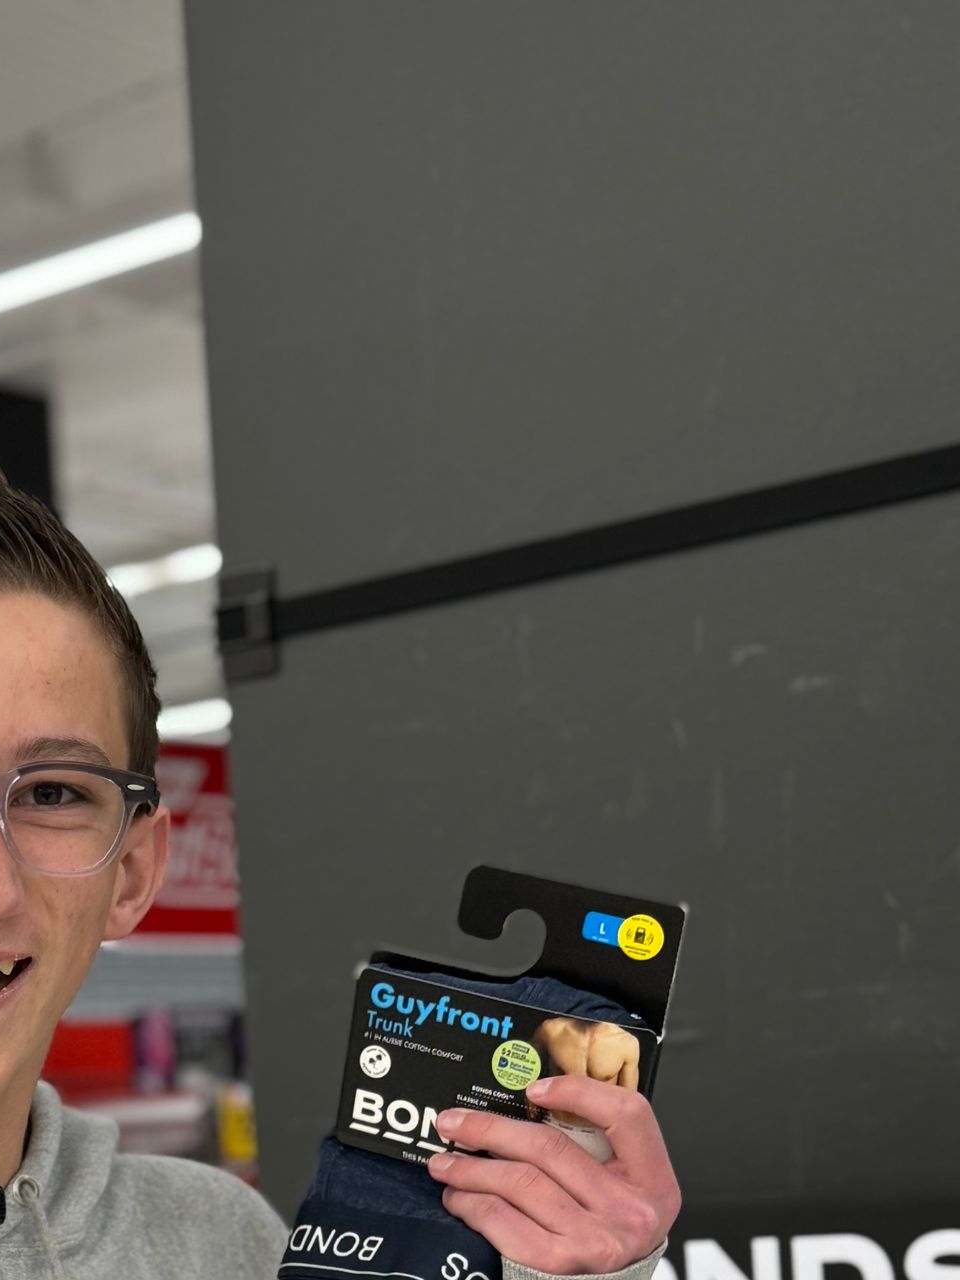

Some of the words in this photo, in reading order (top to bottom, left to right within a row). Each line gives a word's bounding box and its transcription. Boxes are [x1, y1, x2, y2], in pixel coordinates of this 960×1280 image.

[599, 922, 606, 935] L
[367, 1010, 414, 1038] Trunk
[371, 982, 513, 1040] Guyfront
[374, 1033, 382, 1042] IN
[382, 1036, 403, 1047] AUSSIE
[404, 1041, 431, 1053] COTTON
[432, 1048, 464, 1062] COMFORT
[402, 1151, 417, 1161] THIS
